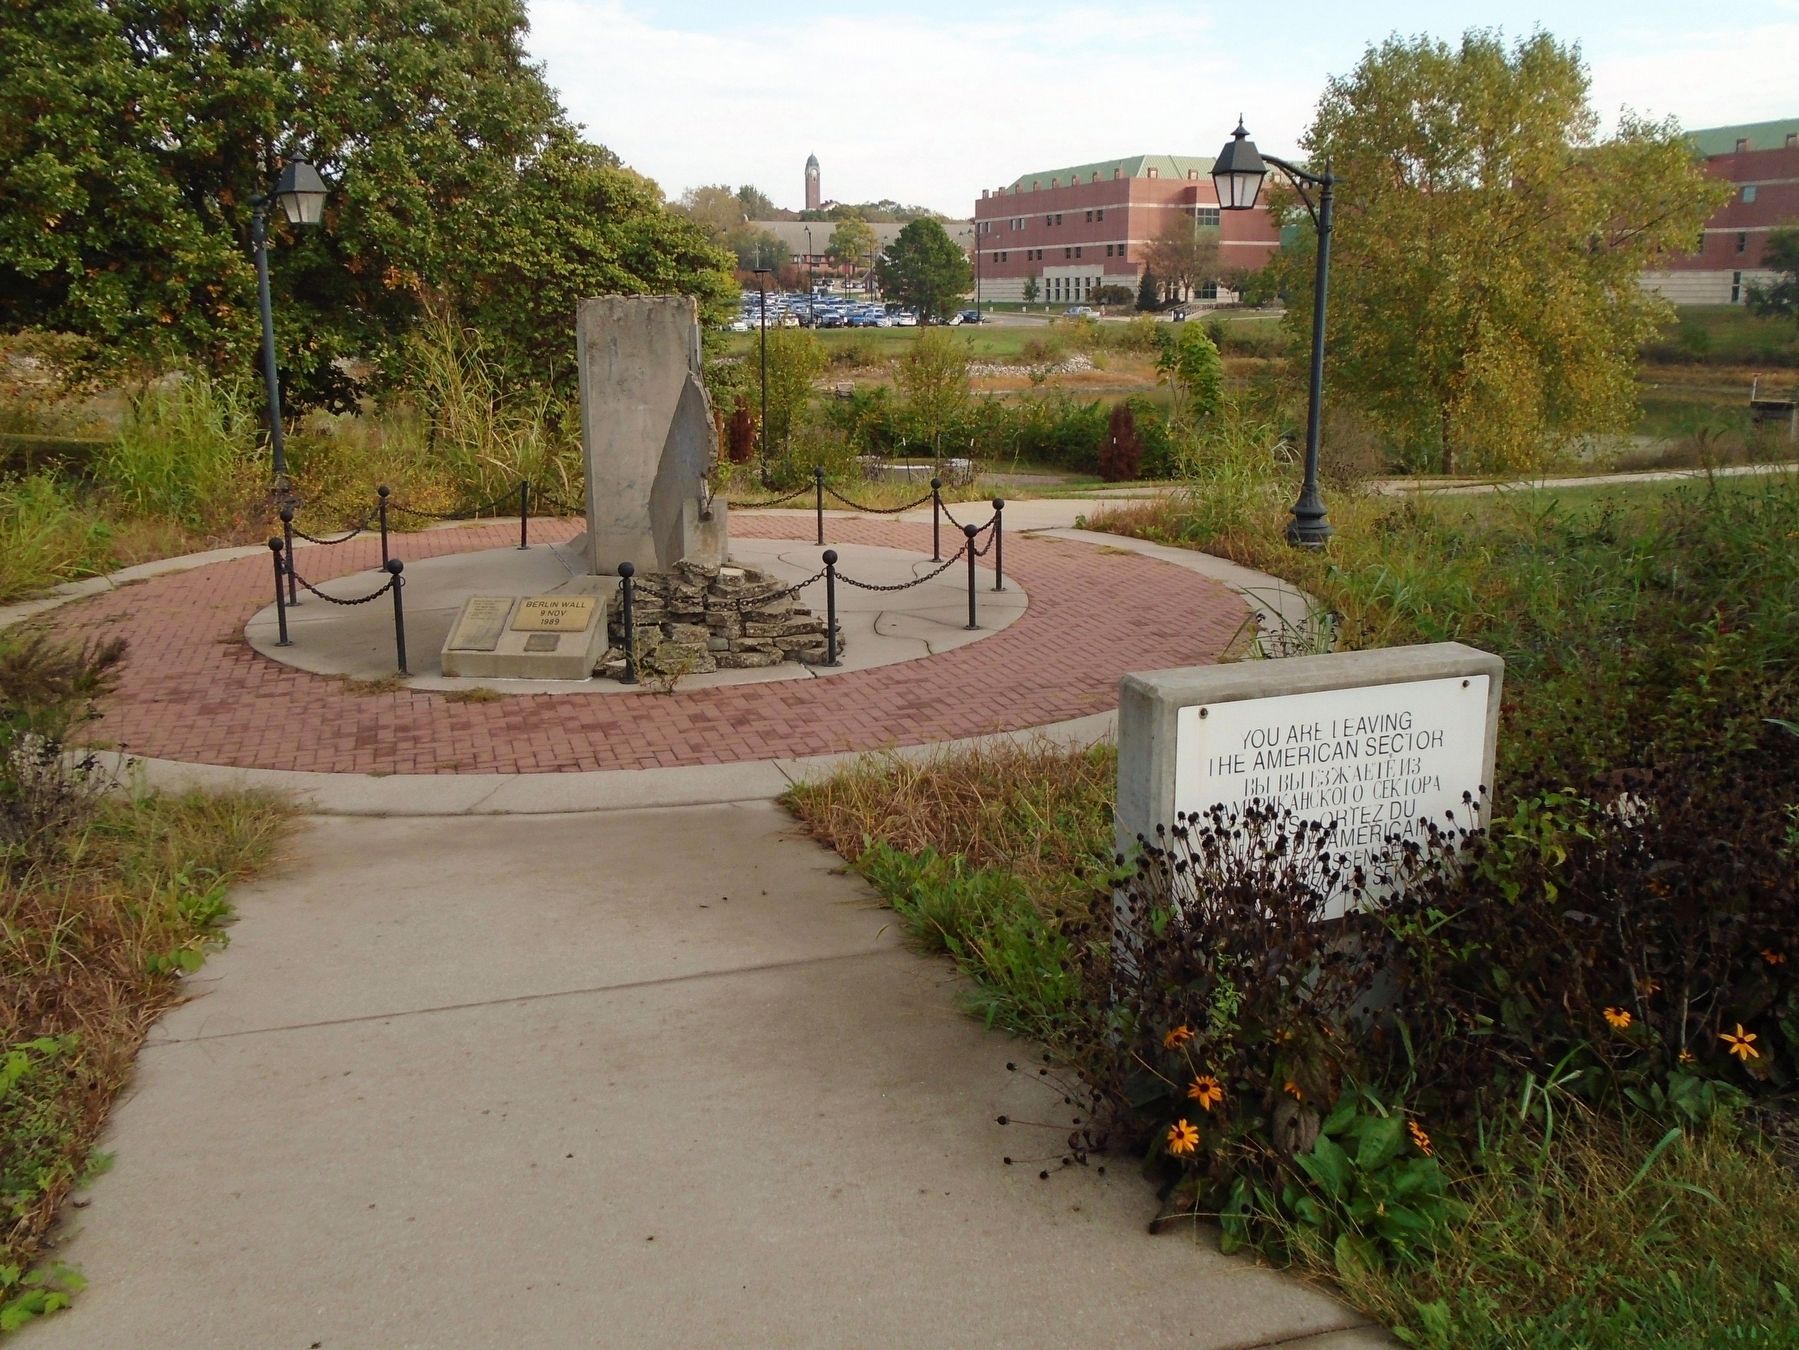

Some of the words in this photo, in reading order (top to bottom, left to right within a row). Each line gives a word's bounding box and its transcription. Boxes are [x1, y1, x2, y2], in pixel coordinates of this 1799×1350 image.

[561, 601, 586, 609] WALL
[1241, 727, 1280, 750] YOU
[1286, 722, 1323, 744] ARE
[1332, 711, 1412, 739] LEAVING
[1207, 753, 1246, 777] THE
[1252, 739, 1359, 771] AMERICAN
[1365, 729, 1444, 757] SECTOR
[1244, 776, 1271, 797] ВЫ
[1399, 757, 1422, 777] ИЗ
[1372, 775, 1441, 800] СЕКТОРА
[1247, 815, 1301, 839] OUS
[1305, 804, 1384, 834] ORTEZ
[1389, 798, 1416, 820] DU
